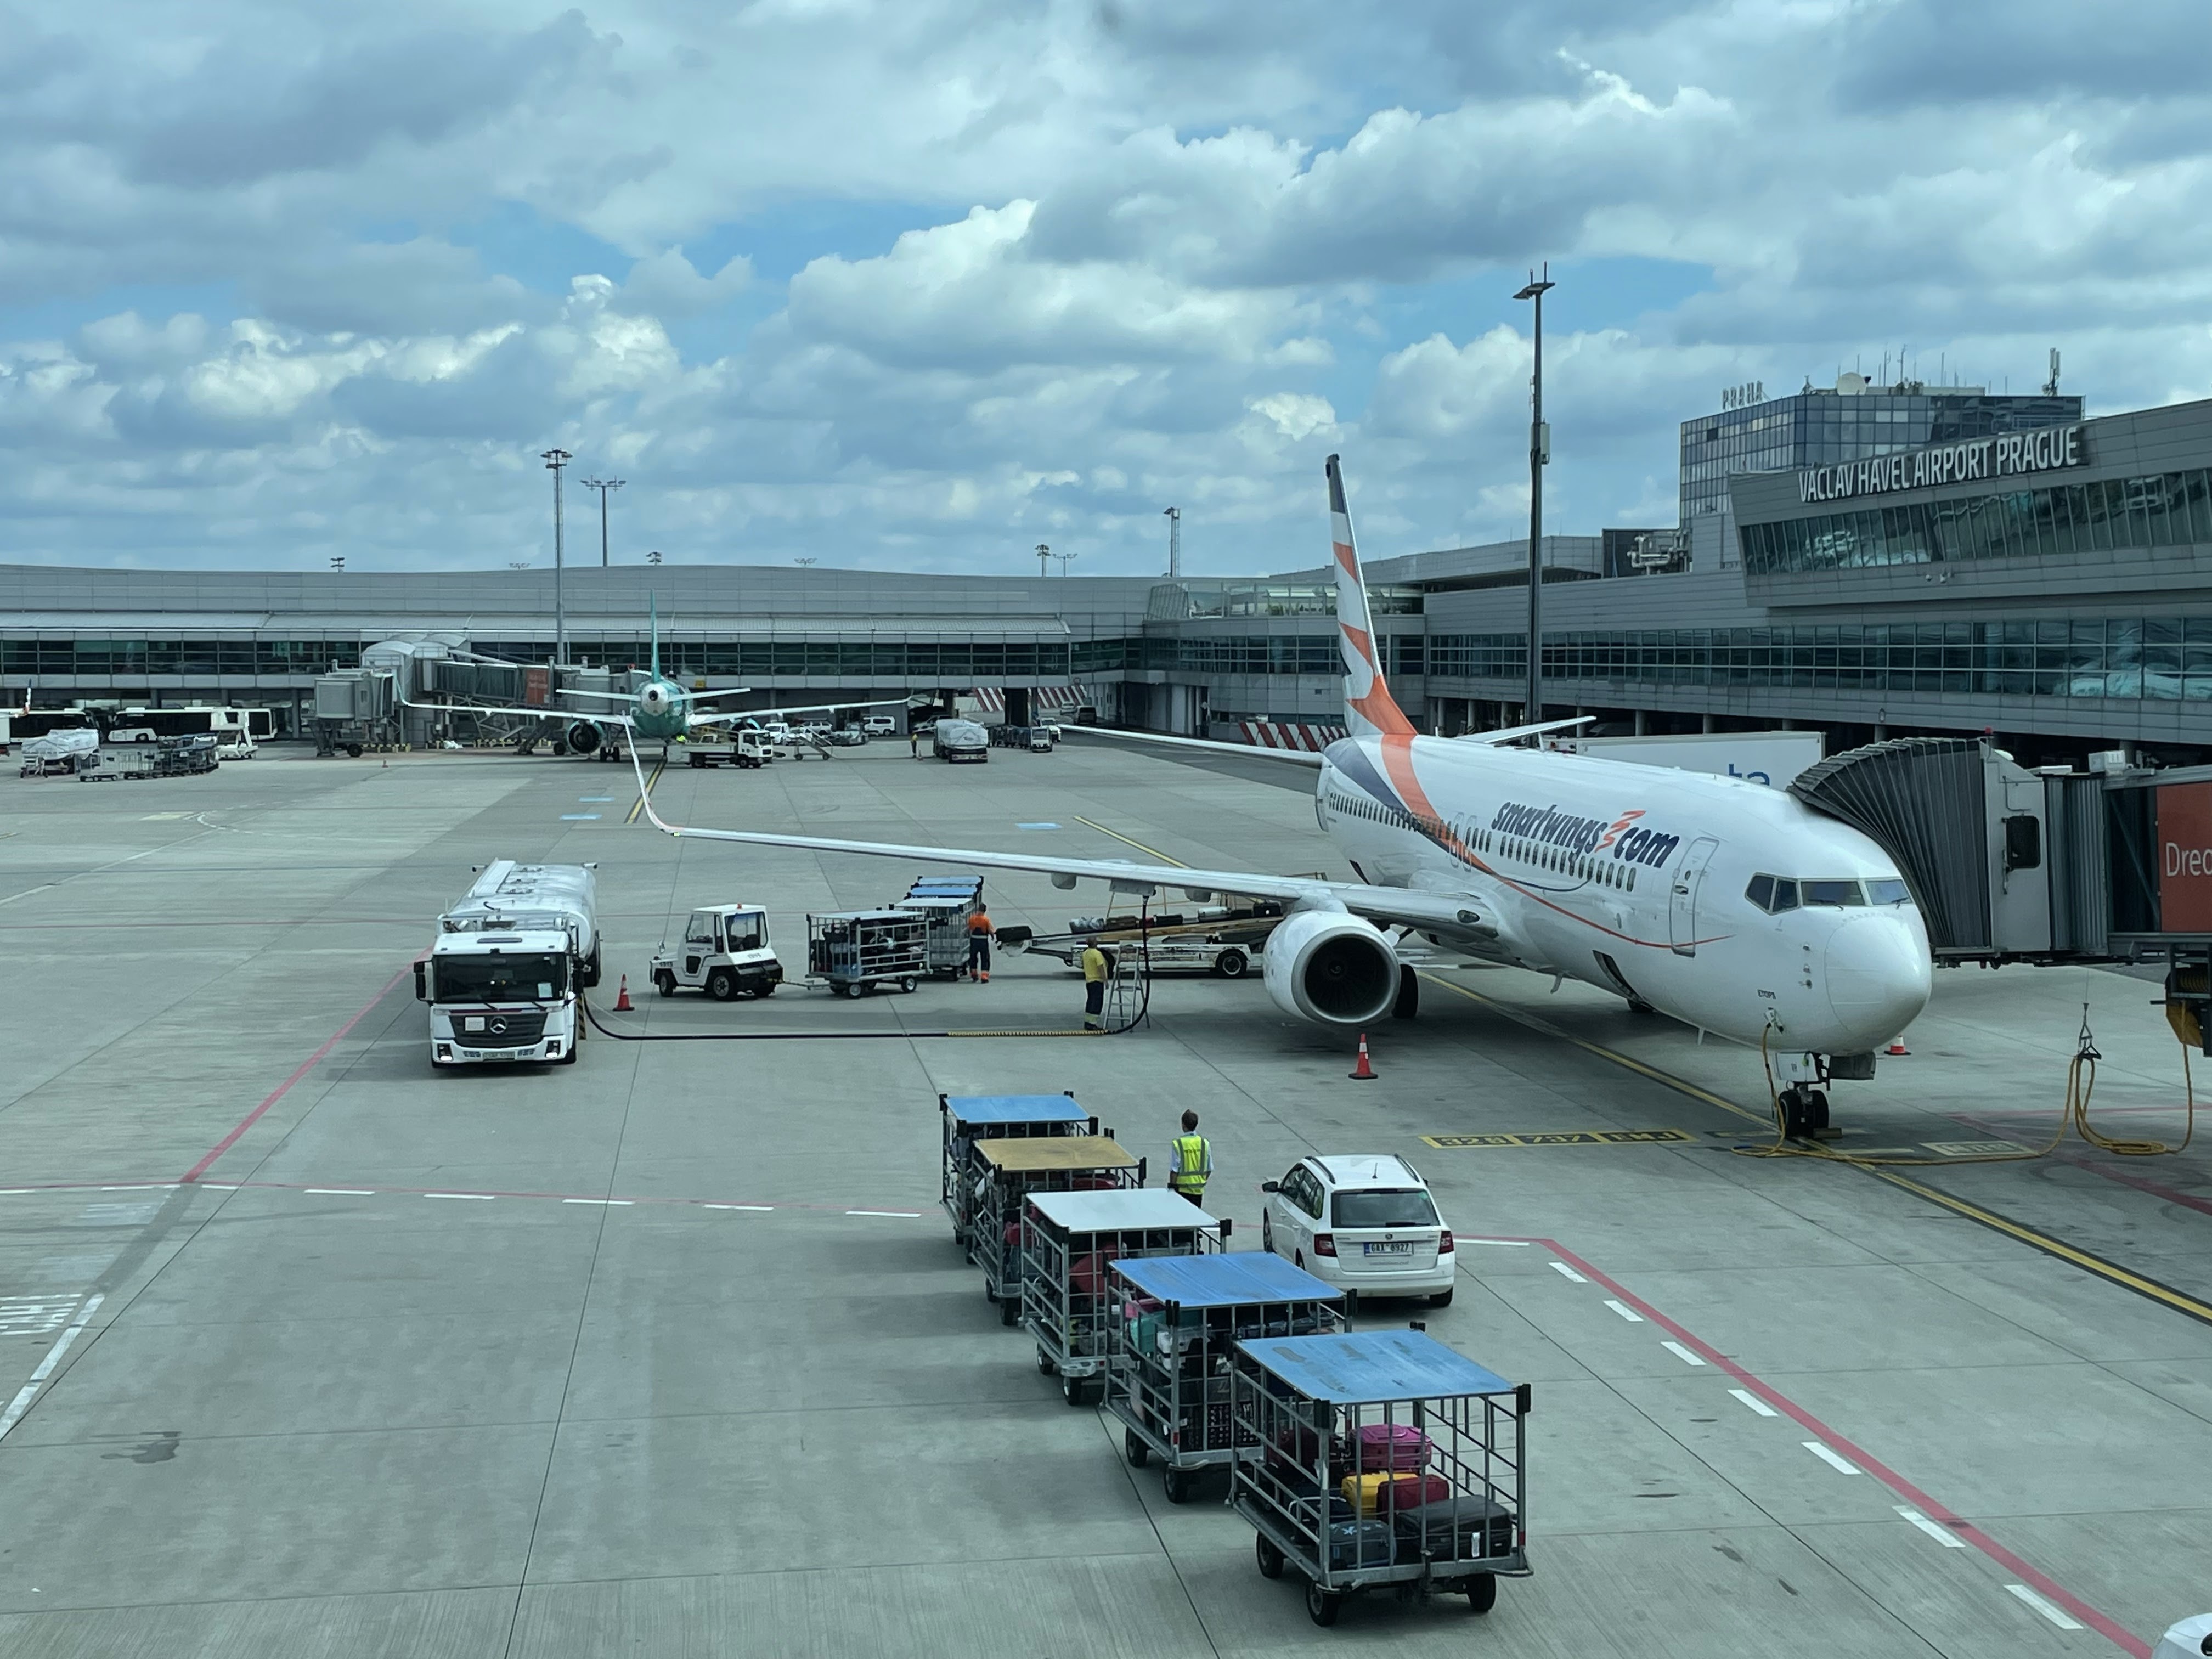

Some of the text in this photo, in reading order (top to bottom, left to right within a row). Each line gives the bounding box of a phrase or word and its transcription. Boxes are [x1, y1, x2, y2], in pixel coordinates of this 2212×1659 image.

[1722, 380, 1763, 410] PRAHA
[1858, 456, 1910, 495] HAVEL
[1913, 441, 1991, 487] AIRPORT
[1995, 427, 2079, 476] PRAGUE
[1526, 1135, 1581, 1143] 737
